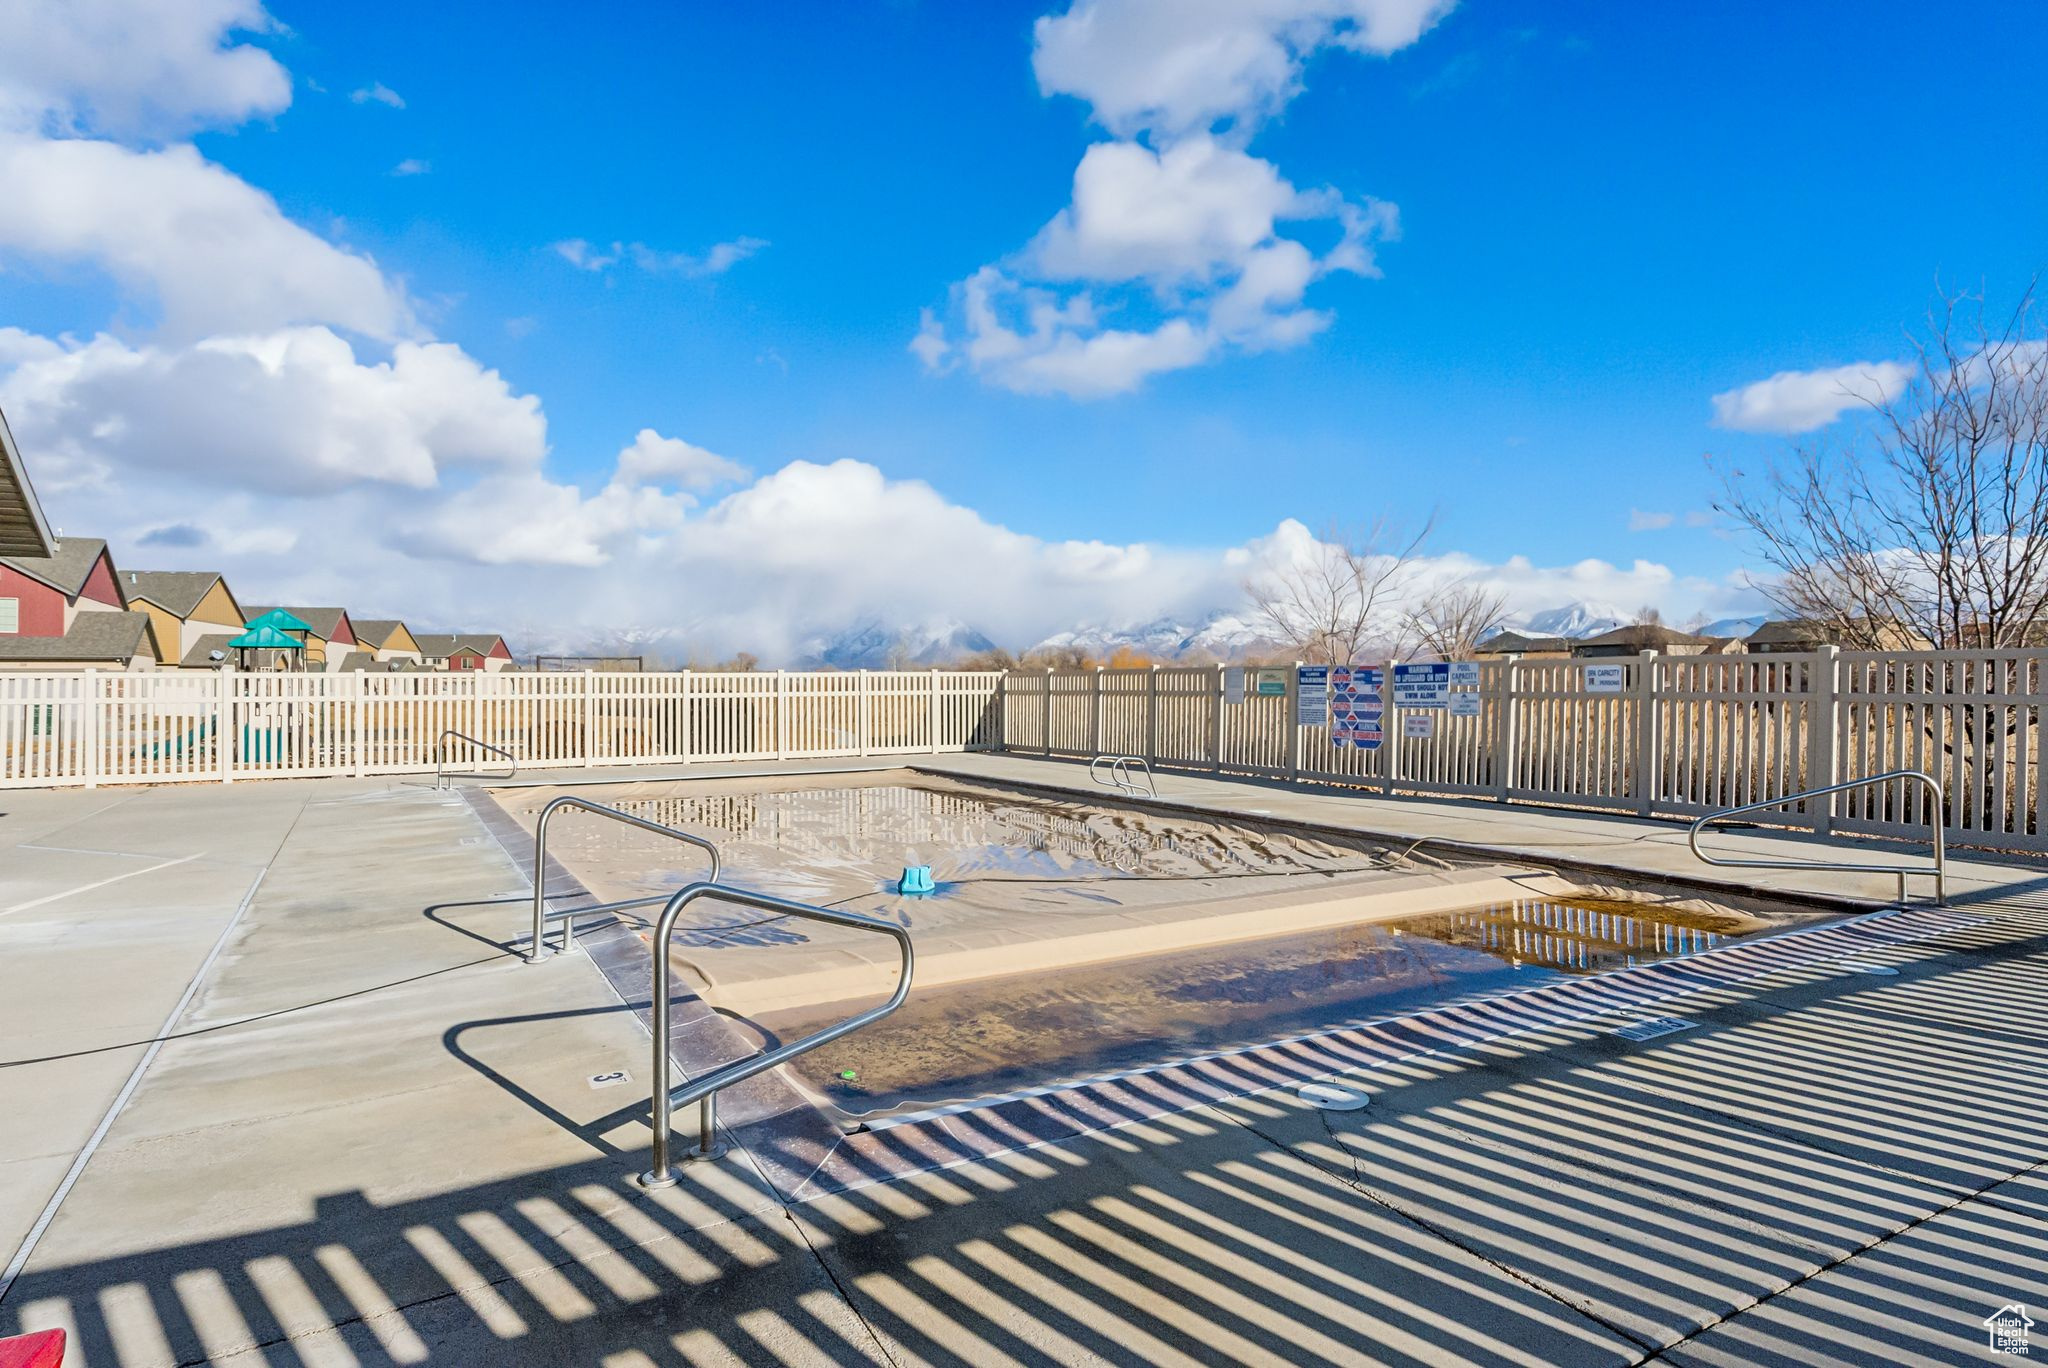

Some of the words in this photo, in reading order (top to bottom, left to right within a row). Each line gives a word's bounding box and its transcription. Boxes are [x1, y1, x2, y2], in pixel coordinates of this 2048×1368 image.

[1408, 665, 1432, 674] WARNING
[1597, 669, 1620, 677] CAPACITY
[1402, 674, 1426, 682] LIFEGUARD
[1427, 674, 1434, 682] ON
[1434, 673, 1448, 681] DUTY
[1451, 672, 1477, 680] CAPACITY
[593, 1072, 624, 1082] 3
